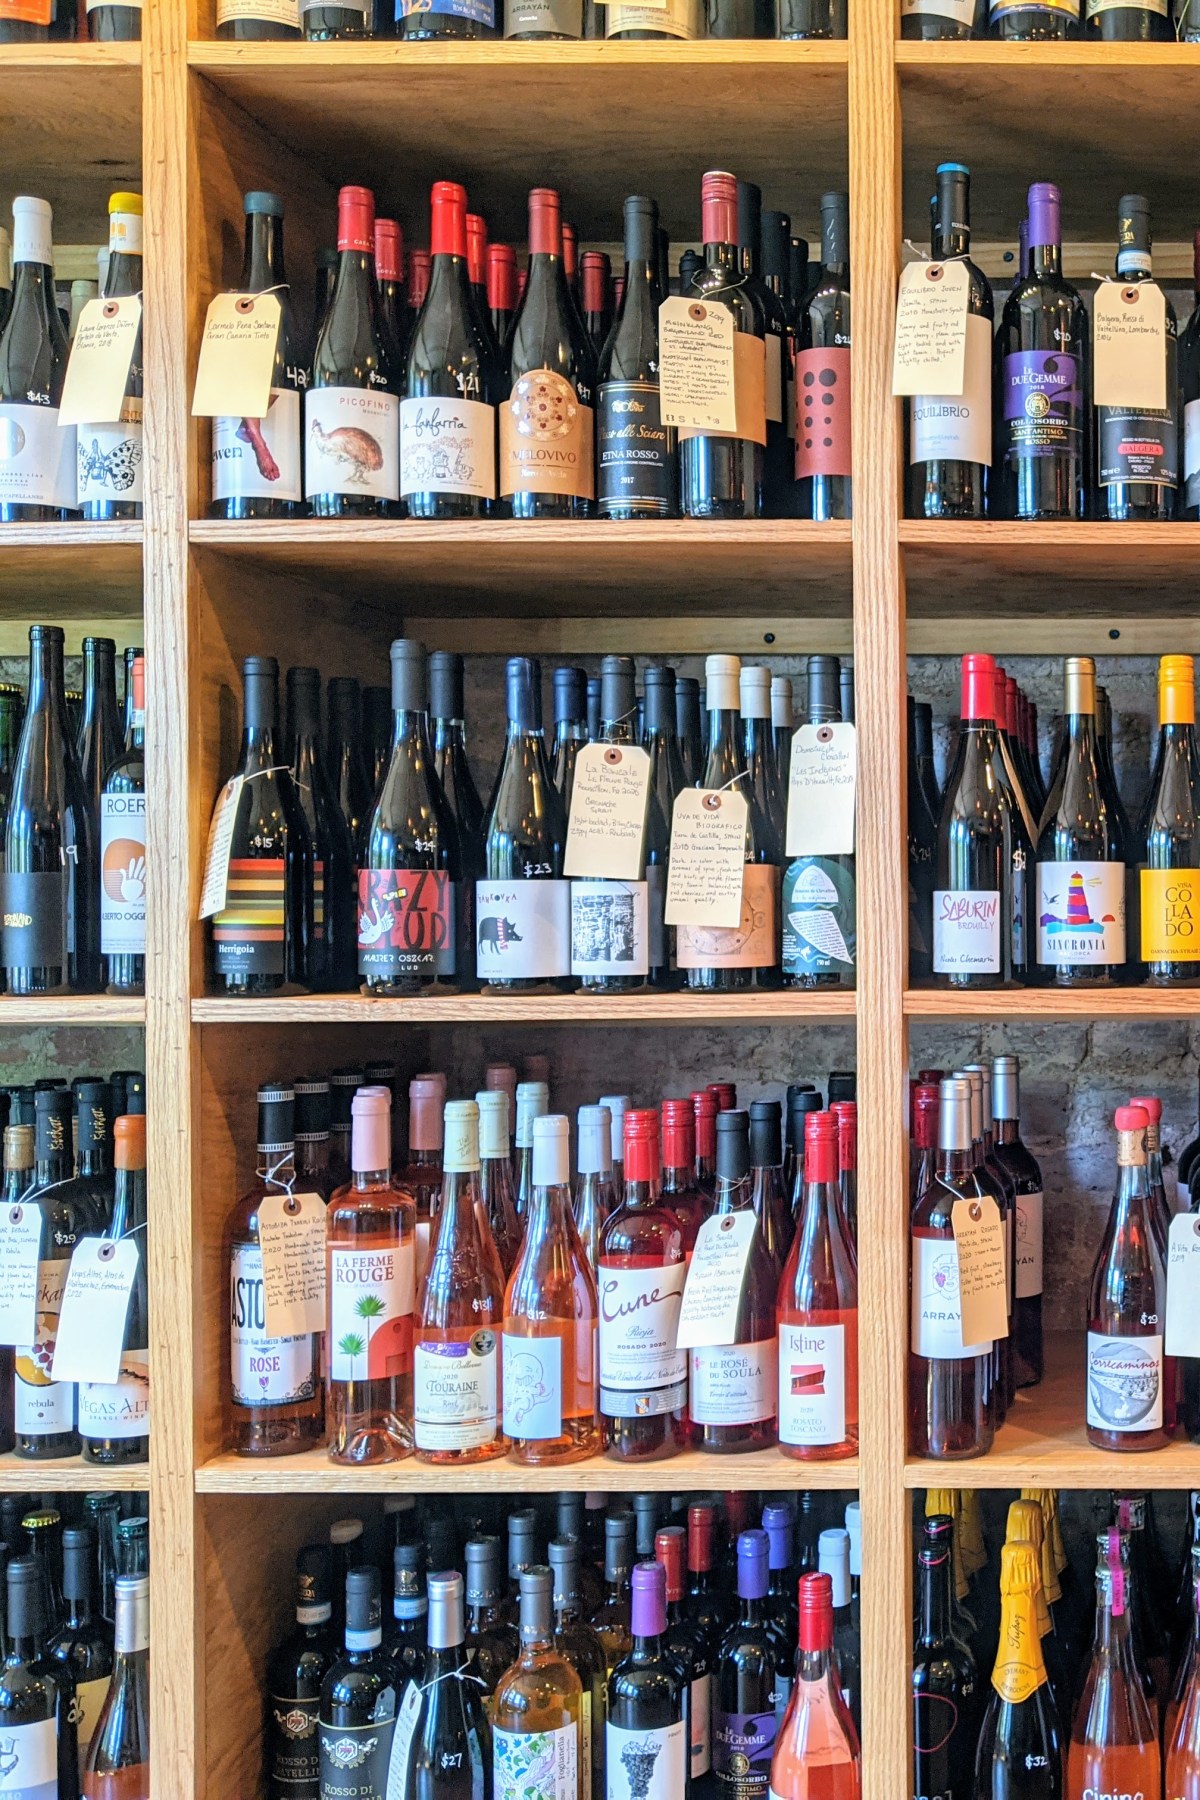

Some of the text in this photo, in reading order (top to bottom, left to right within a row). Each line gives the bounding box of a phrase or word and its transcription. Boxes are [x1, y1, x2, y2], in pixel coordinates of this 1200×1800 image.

[208, 319, 277, 330] Carmelo Santana
[708, 311, 725, 325] 2019
[206, 331, 226, 341] Gran
[1053, 328, 1072, 342] $20
[369, 370, 388, 385] $20
[456, 372, 480, 395] $21
[26, 389, 50, 405] $43
[340, 397, 391, 411] PICOFINO
[411, 408, 466, 439] fanfarria
[1011, 419, 1069, 427] COLLOSORBO
[637, 424, 665, 440] Sciare
[626, 449, 660, 461] ROSSO
[676, 813, 691, 821] UVA
[703, 813, 720, 821] VIDA
[695, 822, 743, 830] BIOGRAFICO
[415, 838, 437, 852] $24
[59, 844, 79, 866] 19
[522, 861, 553, 879] $23
[1177, 881, 1193, 889] VIÑA
[940, 894, 998, 922] SABURIN
[957, 920, 995, 932] BROUILLY
[219, 944, 256, 955] Herrigoia
[1047, 938, 1107, 951] SINCRONIA
[54, 1230, 77, 1246] $29
[335, 1254, 395, 1268] LA FERME
[335, 1266, 395, 1284] ROUGE
[602, 1279, 683, 1323] Cune
[922, 1311, 962, 1321] ARRAY
[625, 1325, 655, 1338] Rioja
[650, 1341, 667, 1349] 2020
[789, 1334, 826, 1354] Istine
[249, 1356, 281, 1373] ROSE
[709, 1361, 719, 1370] LE
[1089, 1351, 1161, 1371] Correcaminos
[709, 1366, 763, 1380] DU SOULA
[425, 1380, 479, 1393] TOURAINE
[28, 1399, 55, 1409] rebula
[792, 1418, 822, 1426] ROSATO
[790, 1426, 827, 1434] TOSCANO
[440, 1752, 463, 1769] $27
[1025, 1753, 1048, 1770] $32
[324, 1783, 374, 1797] ROSSO DI
